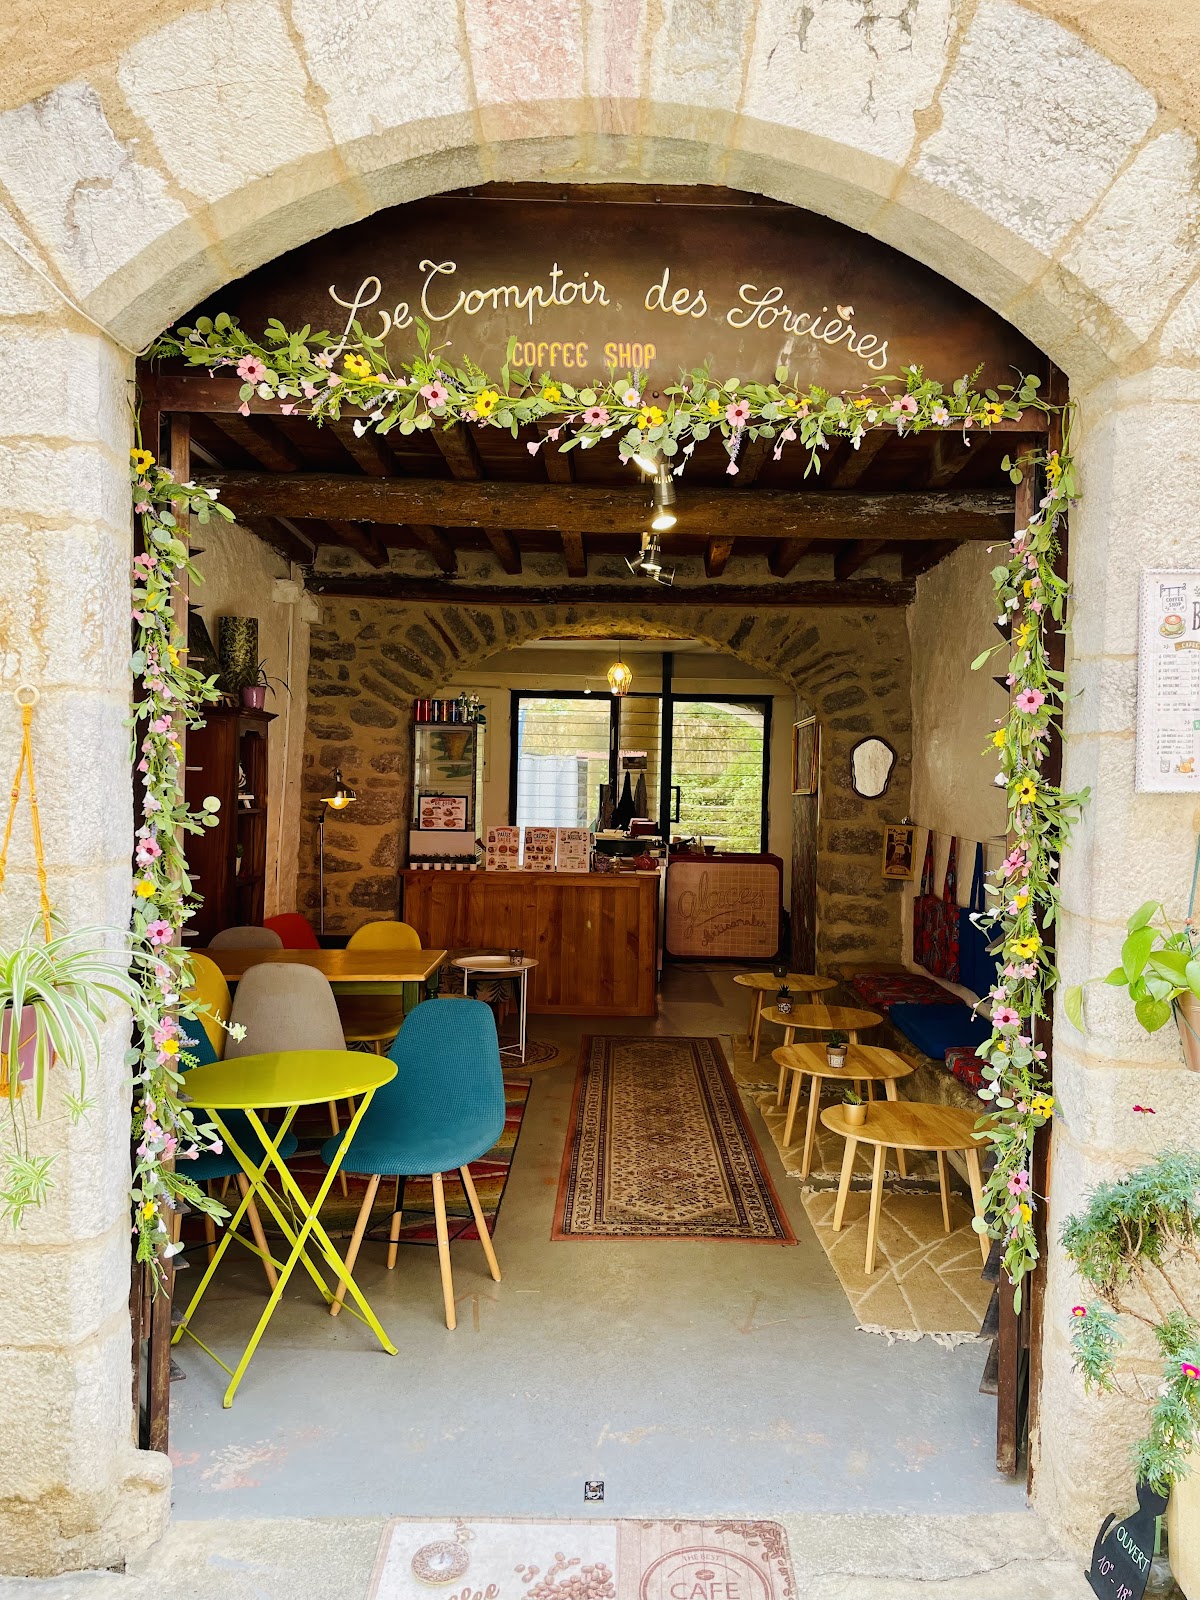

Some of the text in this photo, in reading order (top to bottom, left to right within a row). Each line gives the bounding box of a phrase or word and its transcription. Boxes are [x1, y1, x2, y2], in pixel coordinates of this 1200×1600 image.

[323, 276, 413, 359] Le
[419, 259, 610, 325] Comptoir
[644, 267, 708, 319] des
[512, 342, 657, 369] COFFEE SHOP
[683, 1553, 721, 1562] THE BEST
[1116, 1526, 1151, 1573] OUVERT
[670, 1582, 740, 1600] CAFE
